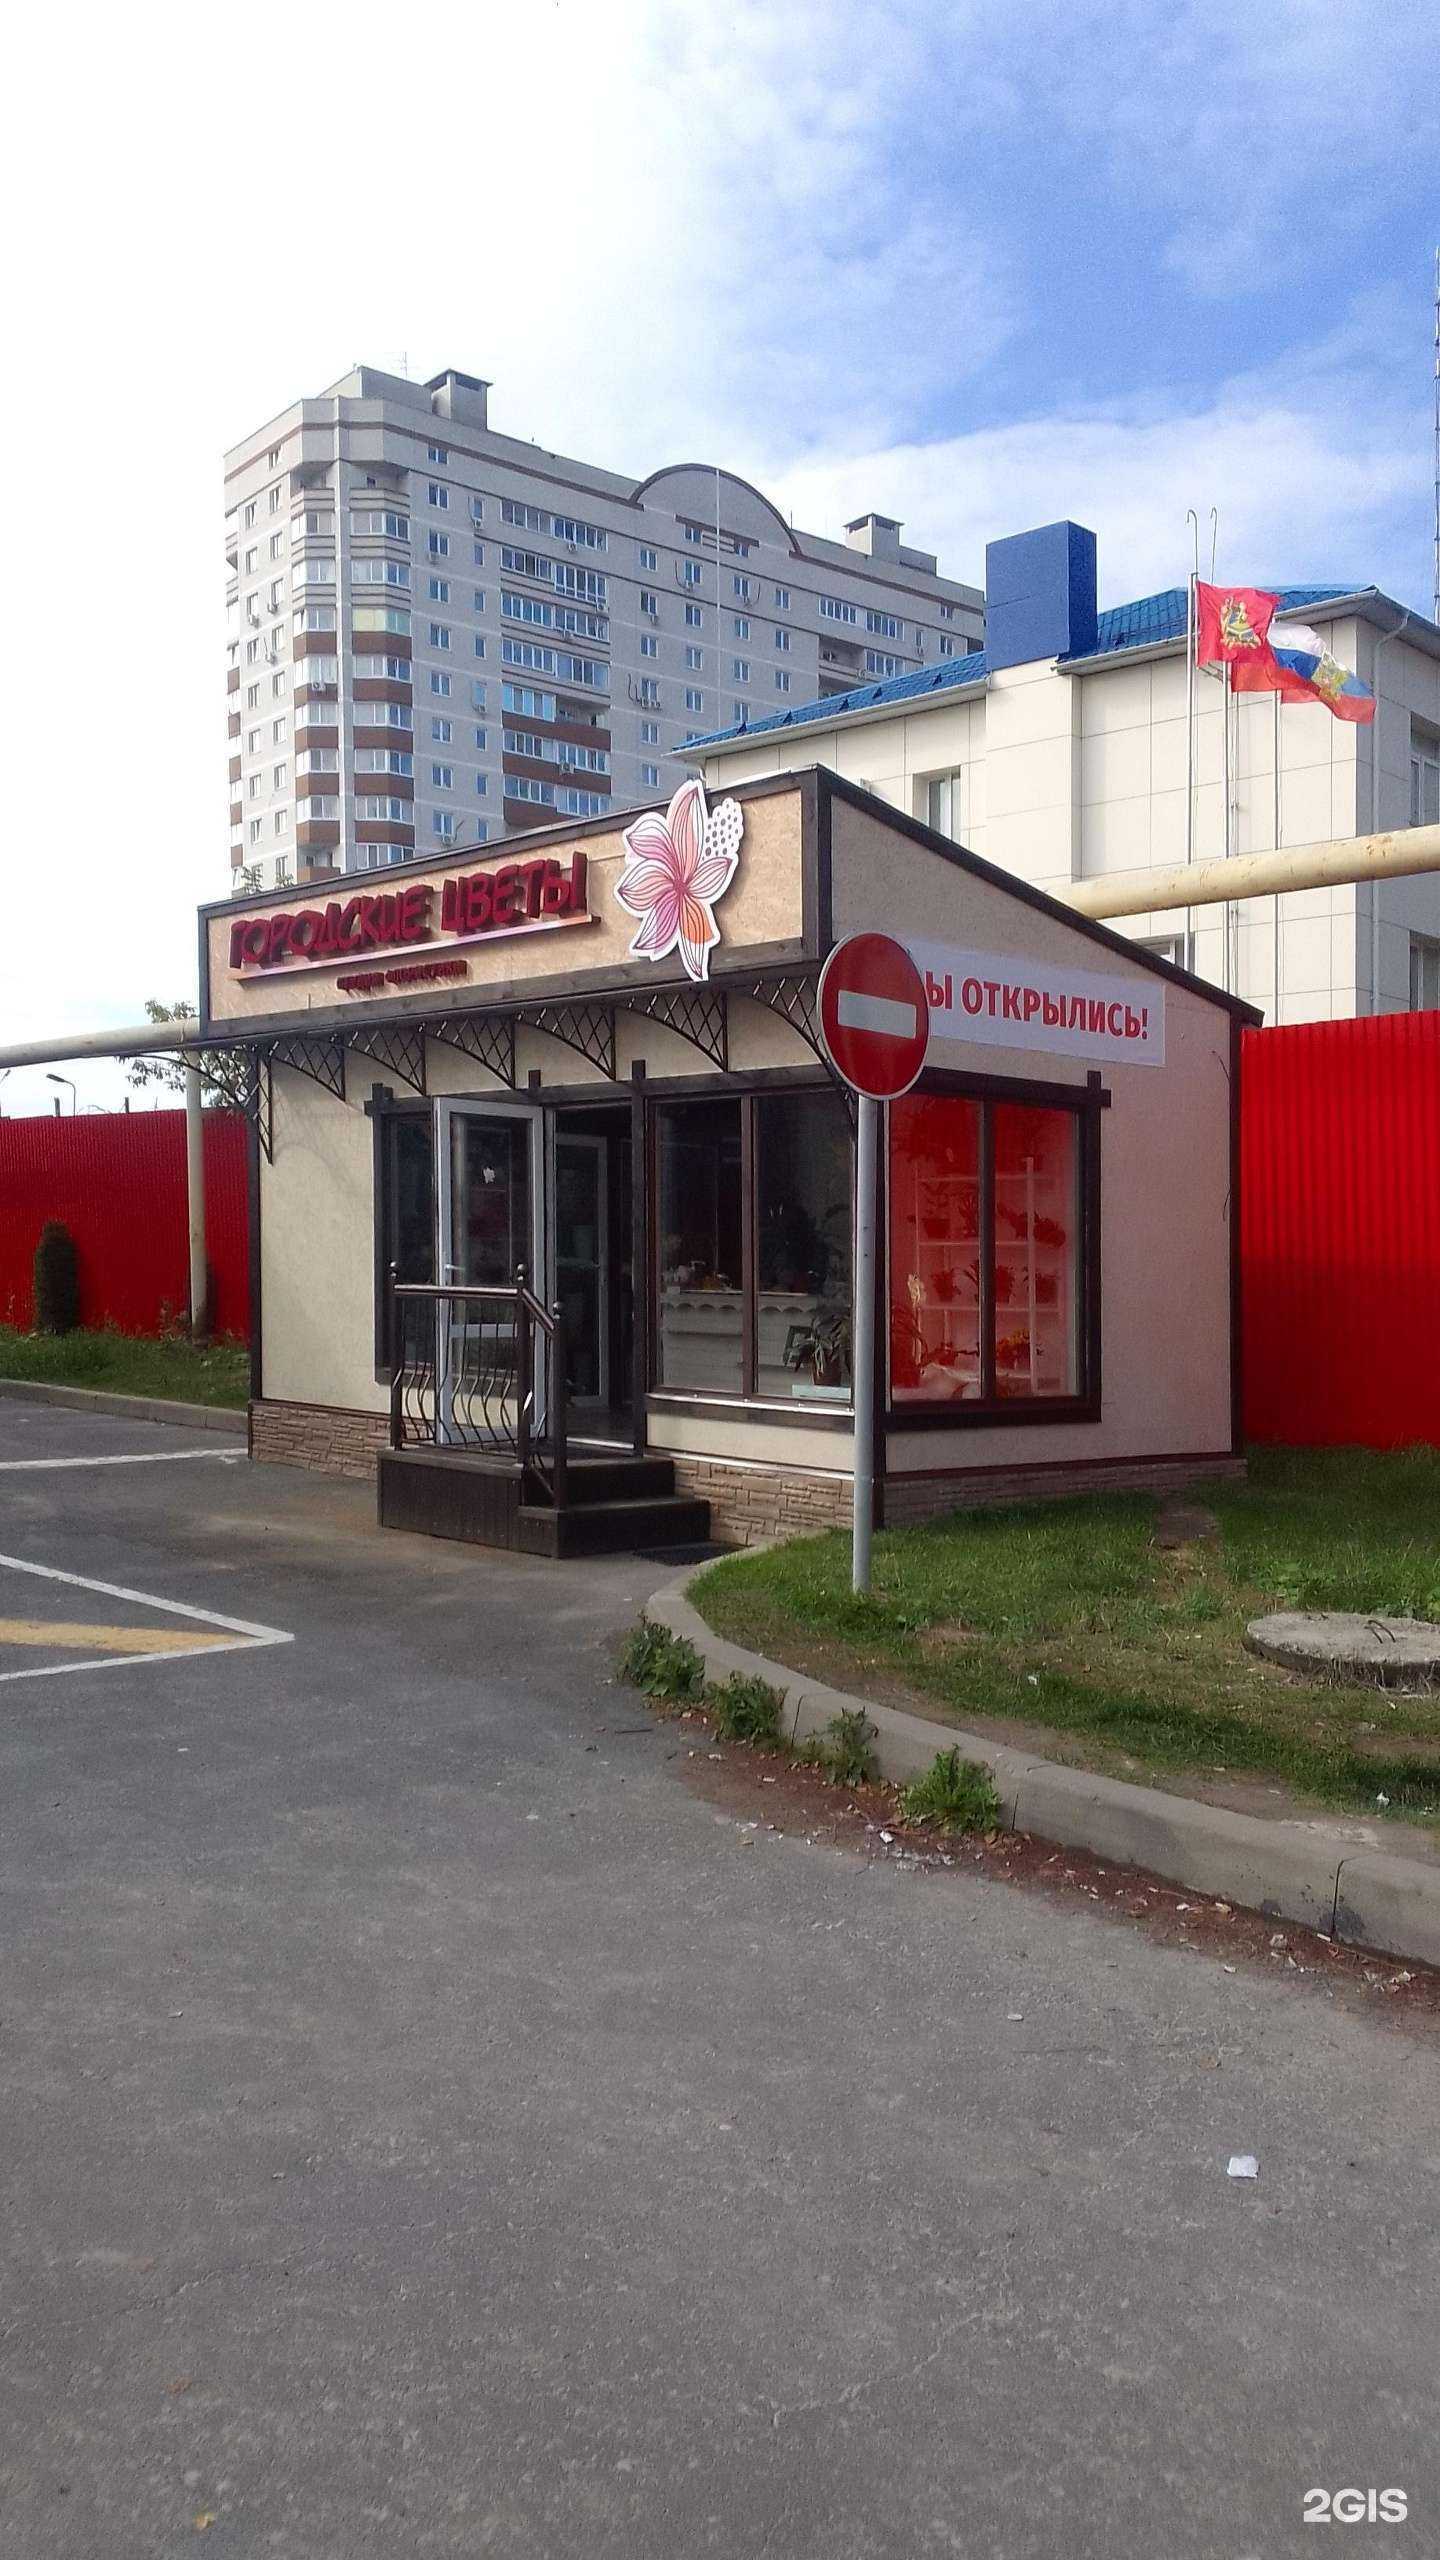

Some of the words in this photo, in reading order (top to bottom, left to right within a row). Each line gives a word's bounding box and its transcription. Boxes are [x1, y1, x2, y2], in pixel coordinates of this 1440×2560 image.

[229, 884, 432, 968] ГОРОДСКИЕ
[441, 851, 588, 934] ЦВЕТЫ
[925, 970, 953, 1010] Ы
[961, 977, 1148, 1040] ОТКРЫЛИСЬ!
